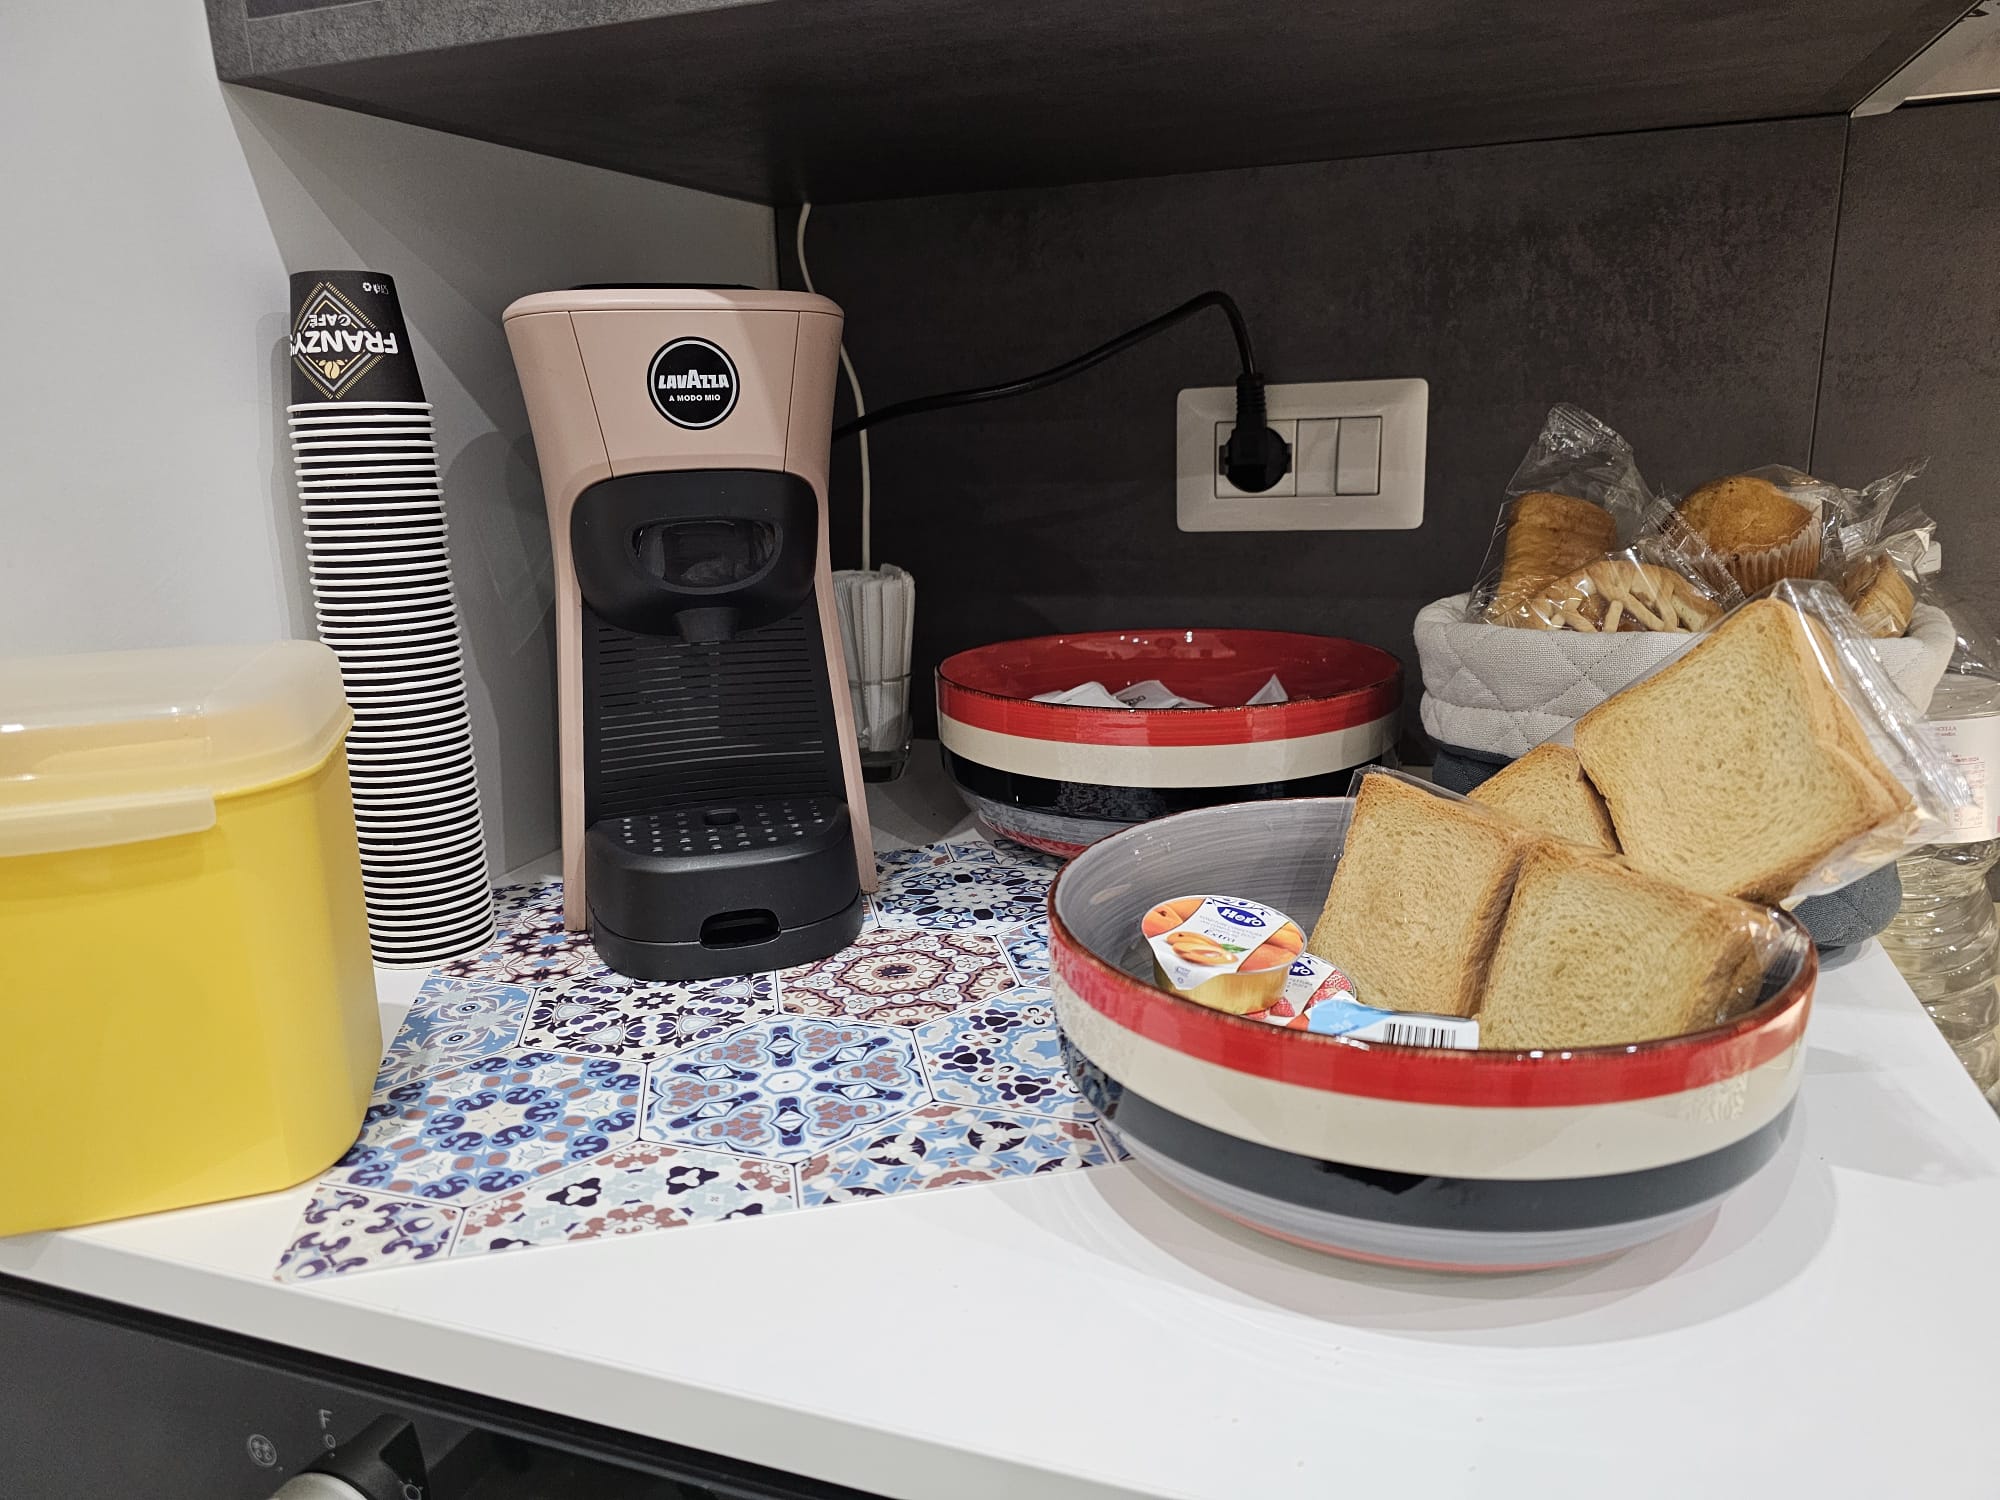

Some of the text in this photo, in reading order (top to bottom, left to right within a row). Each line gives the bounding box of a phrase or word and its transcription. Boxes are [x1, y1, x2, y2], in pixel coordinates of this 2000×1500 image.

[309, 314, 351, 328] CAFÉ
[658, 369, 730, 389] LAVAZZA
[669, 394, 721, 402] A MODO MIO
[1220, 908, 1263, 926] Hero
